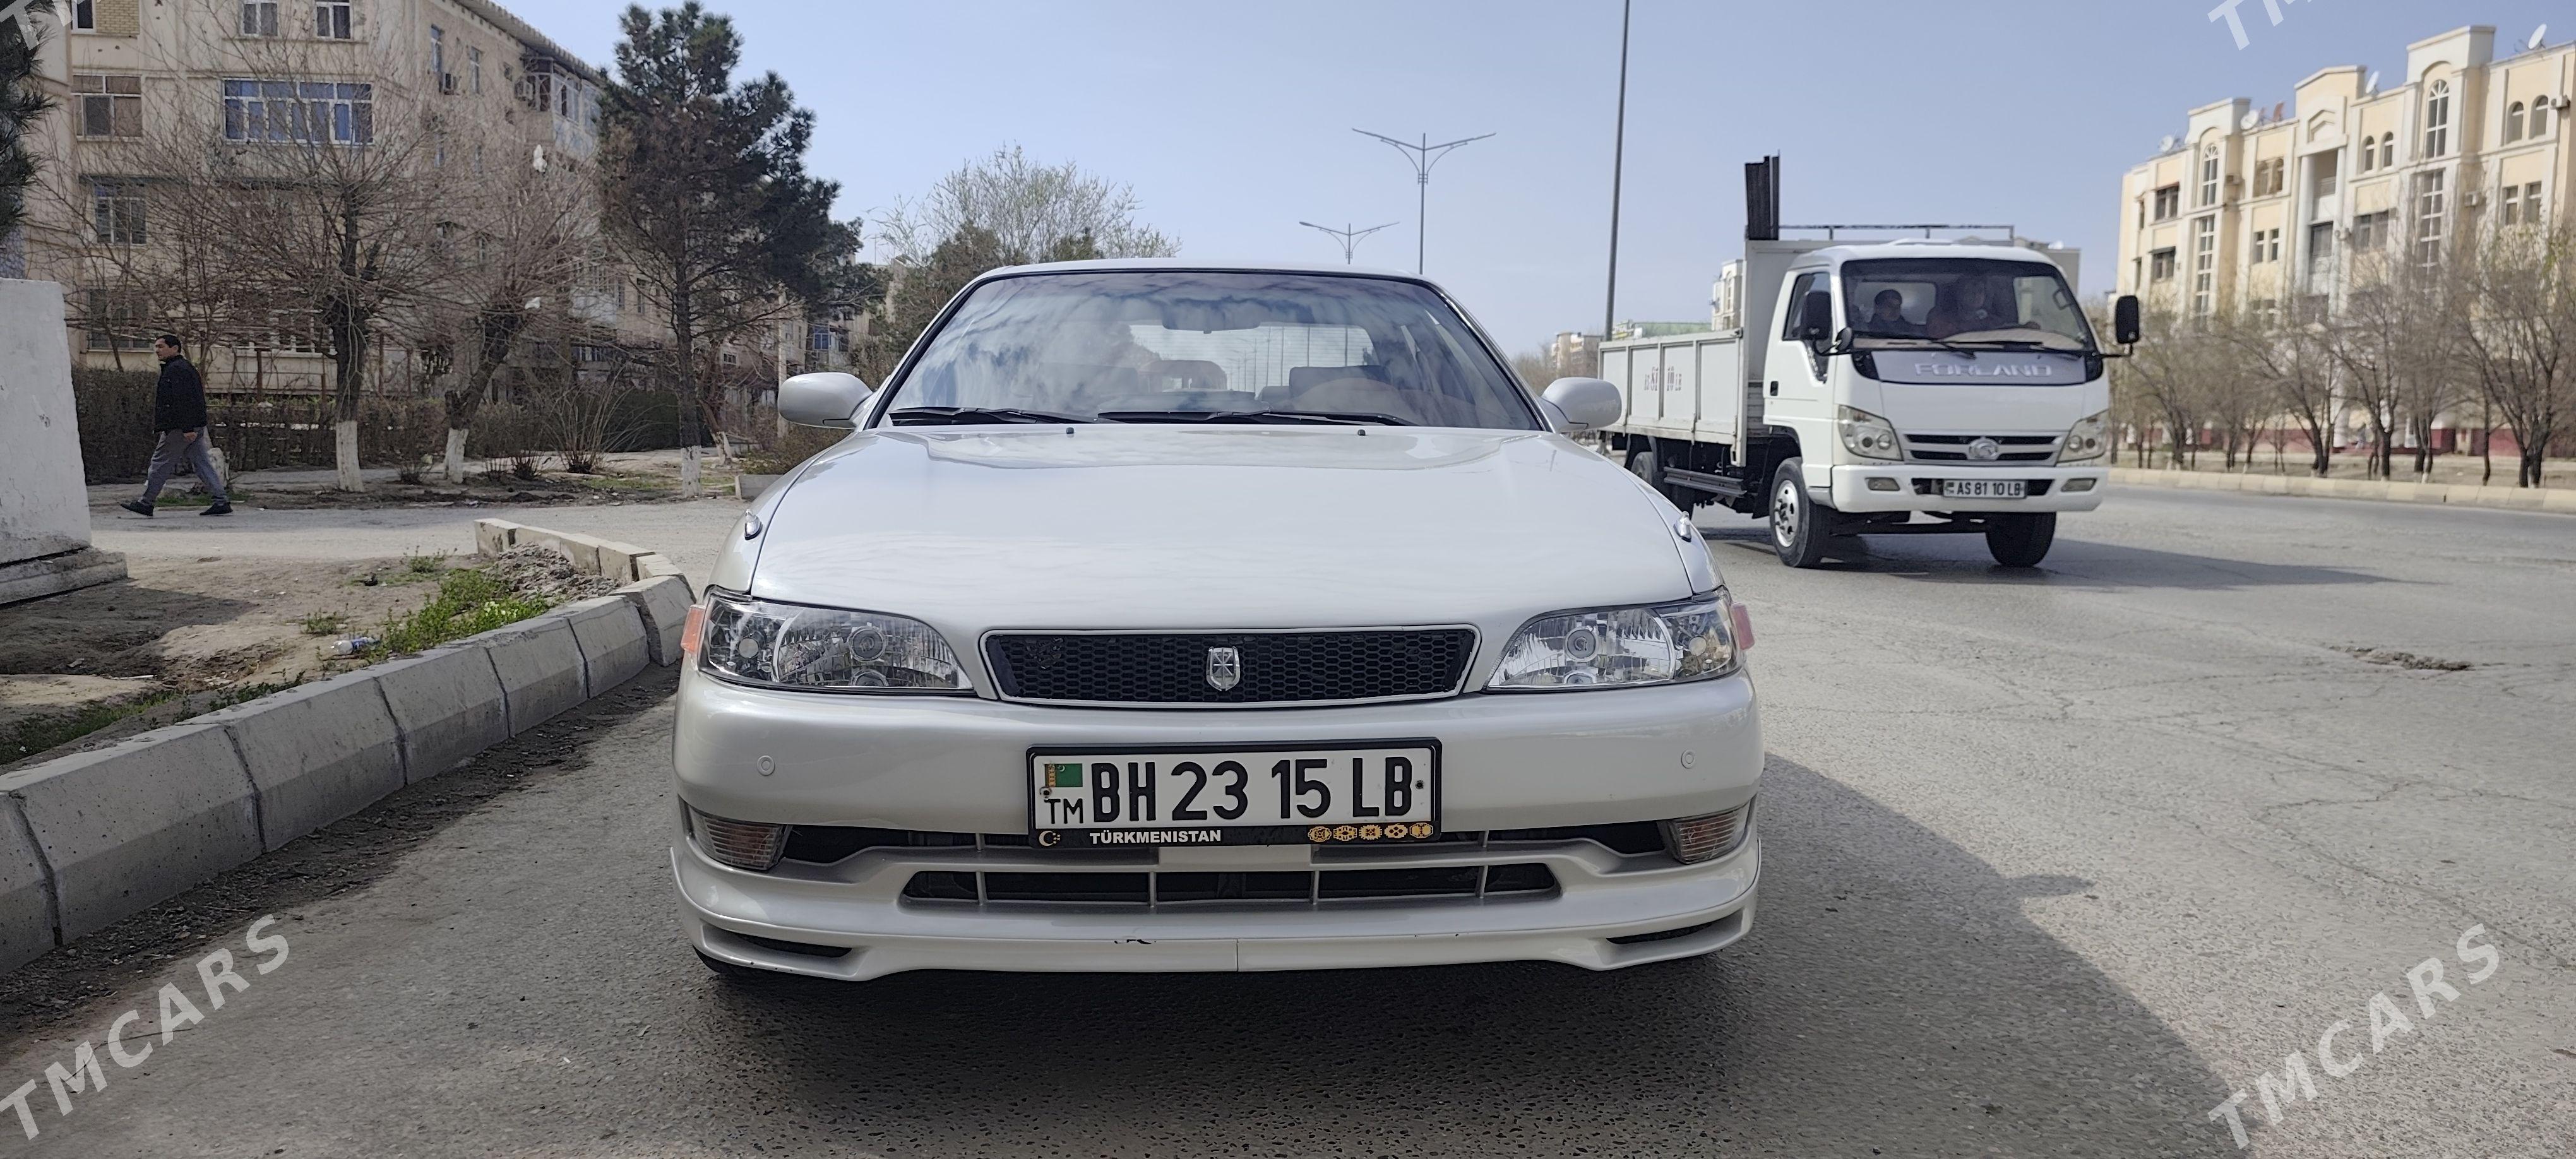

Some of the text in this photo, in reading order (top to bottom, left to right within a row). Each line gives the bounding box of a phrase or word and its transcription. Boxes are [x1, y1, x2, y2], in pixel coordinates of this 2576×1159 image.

[1914, 363, 2051, 377] FORLAND
[1957, 482, 2020, 496] AS 81 10 LB
[1044, 756, 1412, 824] TM BH 23 15 LB
[1089, 829, 1222, 845] TÜRKMENISTAN
